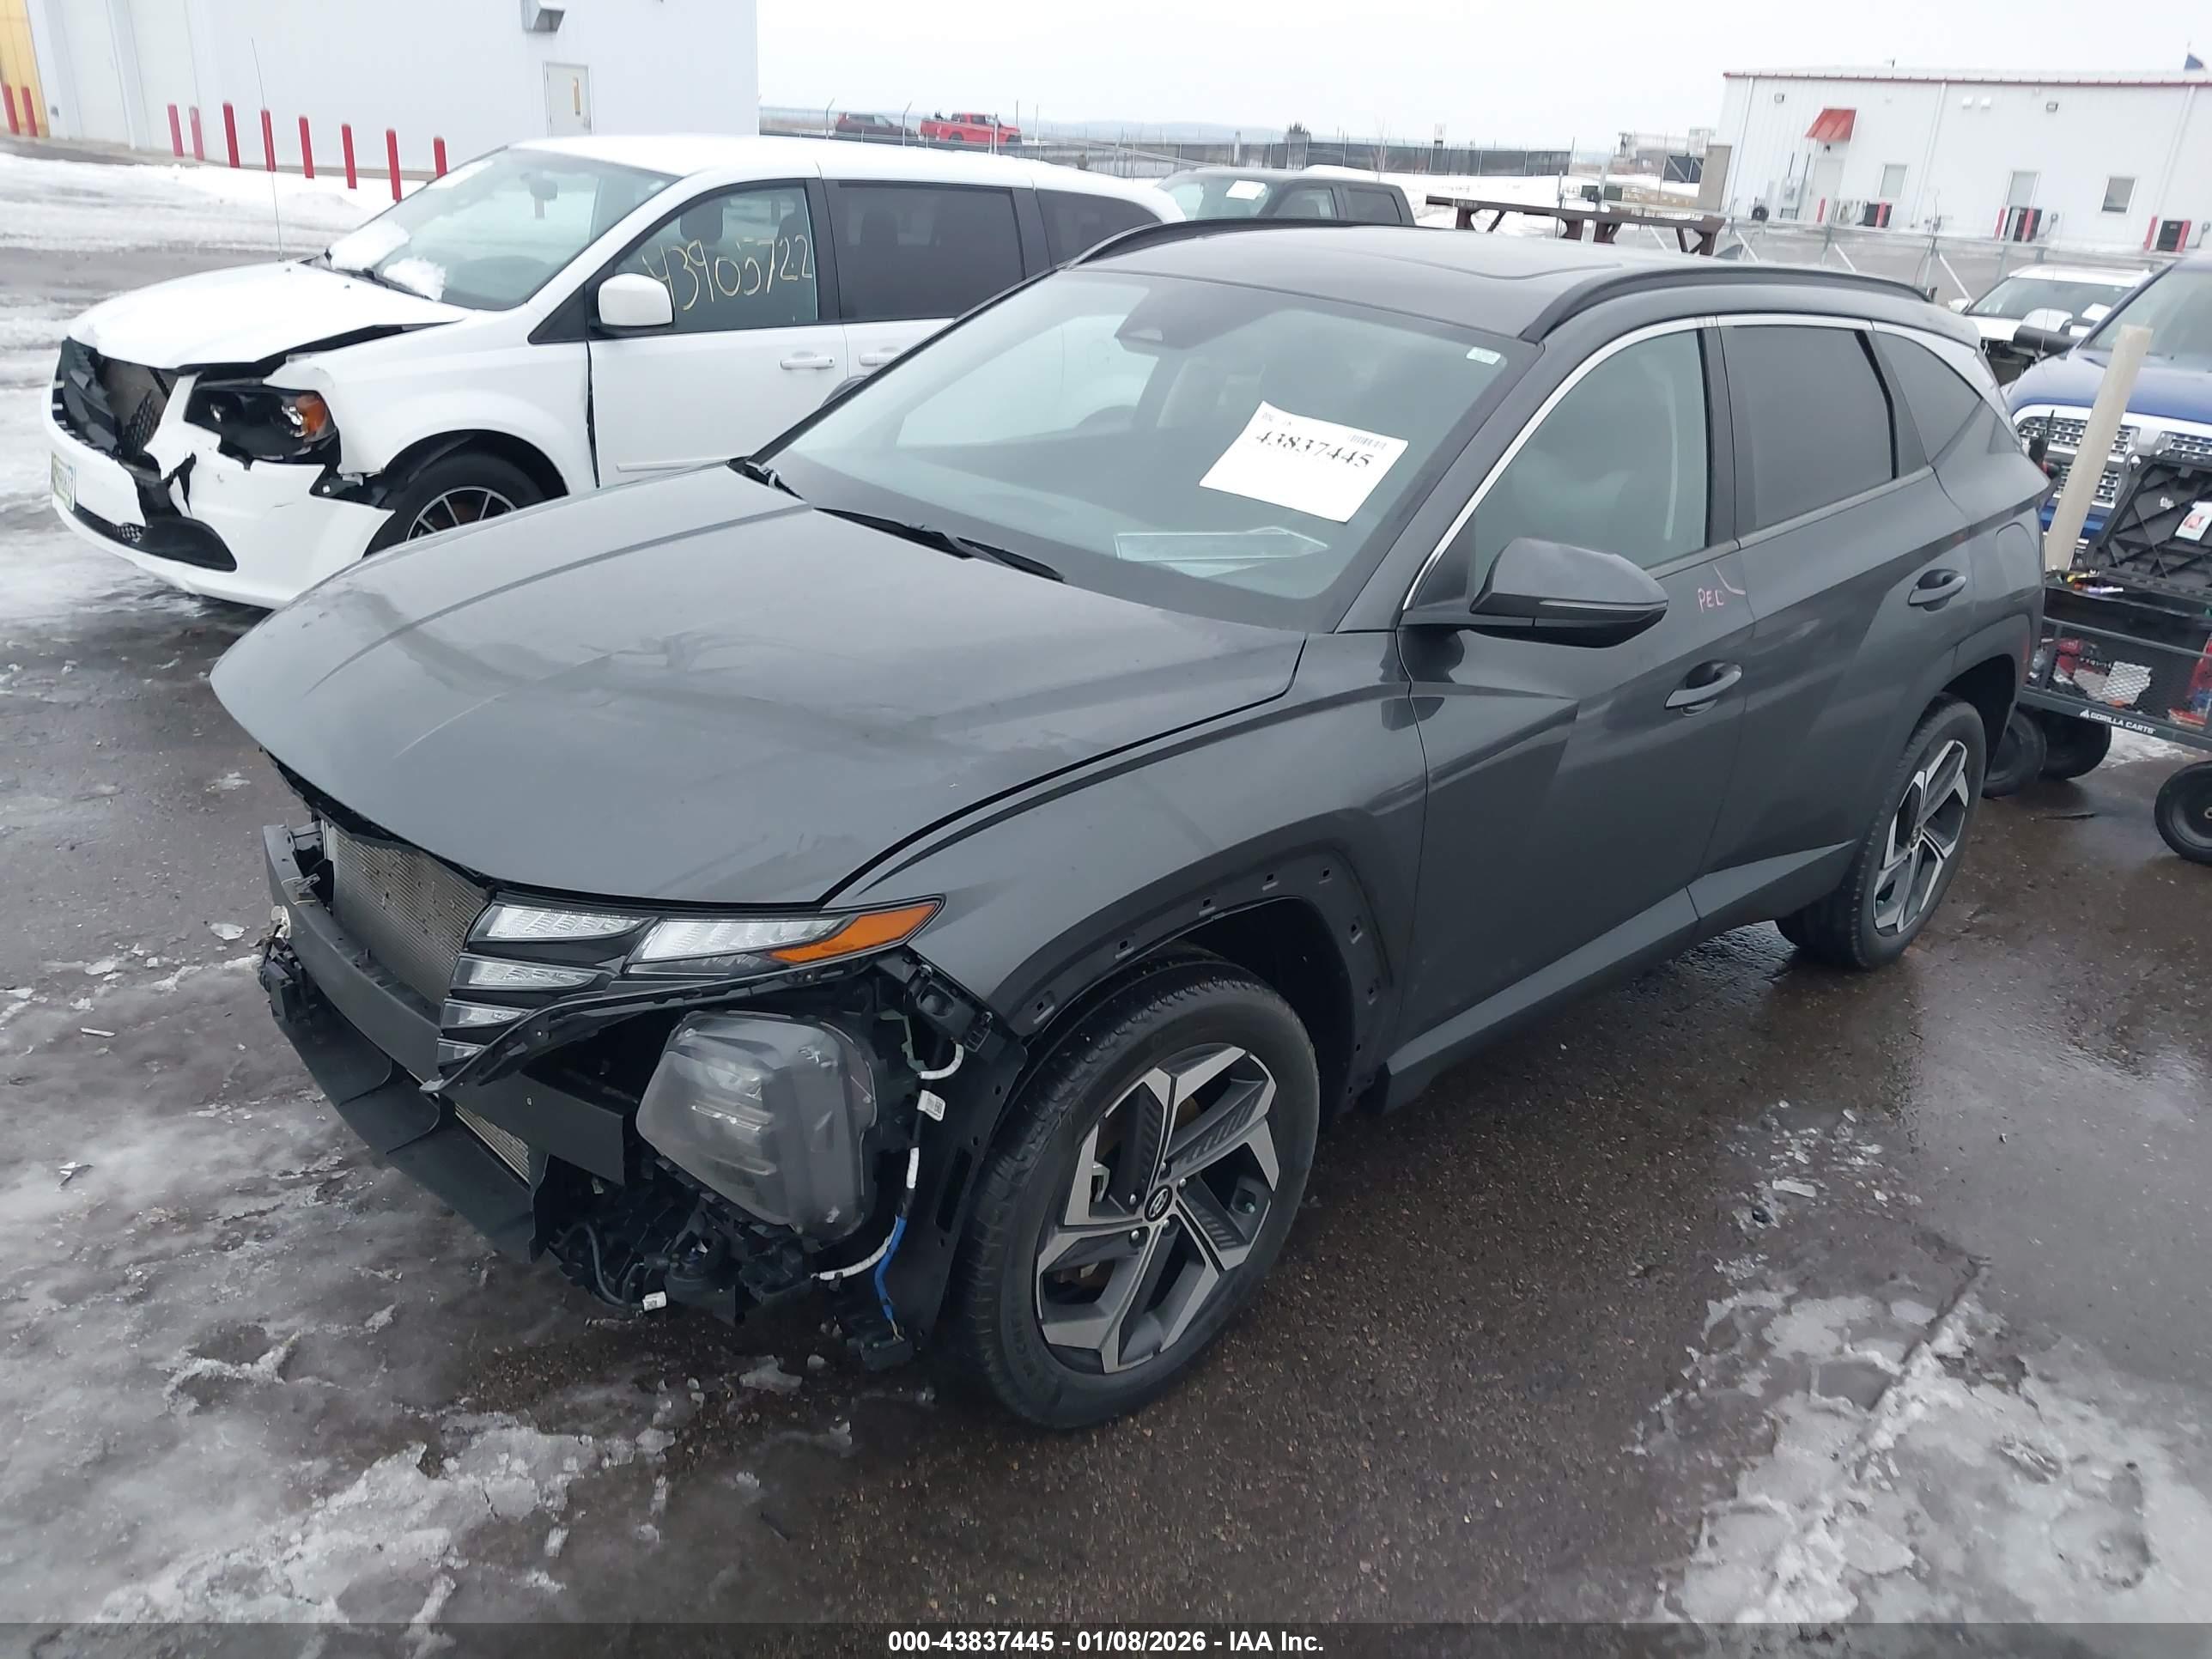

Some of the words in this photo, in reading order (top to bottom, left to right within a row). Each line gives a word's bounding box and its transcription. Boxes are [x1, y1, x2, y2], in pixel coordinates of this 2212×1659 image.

[1256, 431, 1374, 467] 43837445
[2090, 712, 2124, 726] GORILLA
[2125, 721, 2156, 734] CARTS
